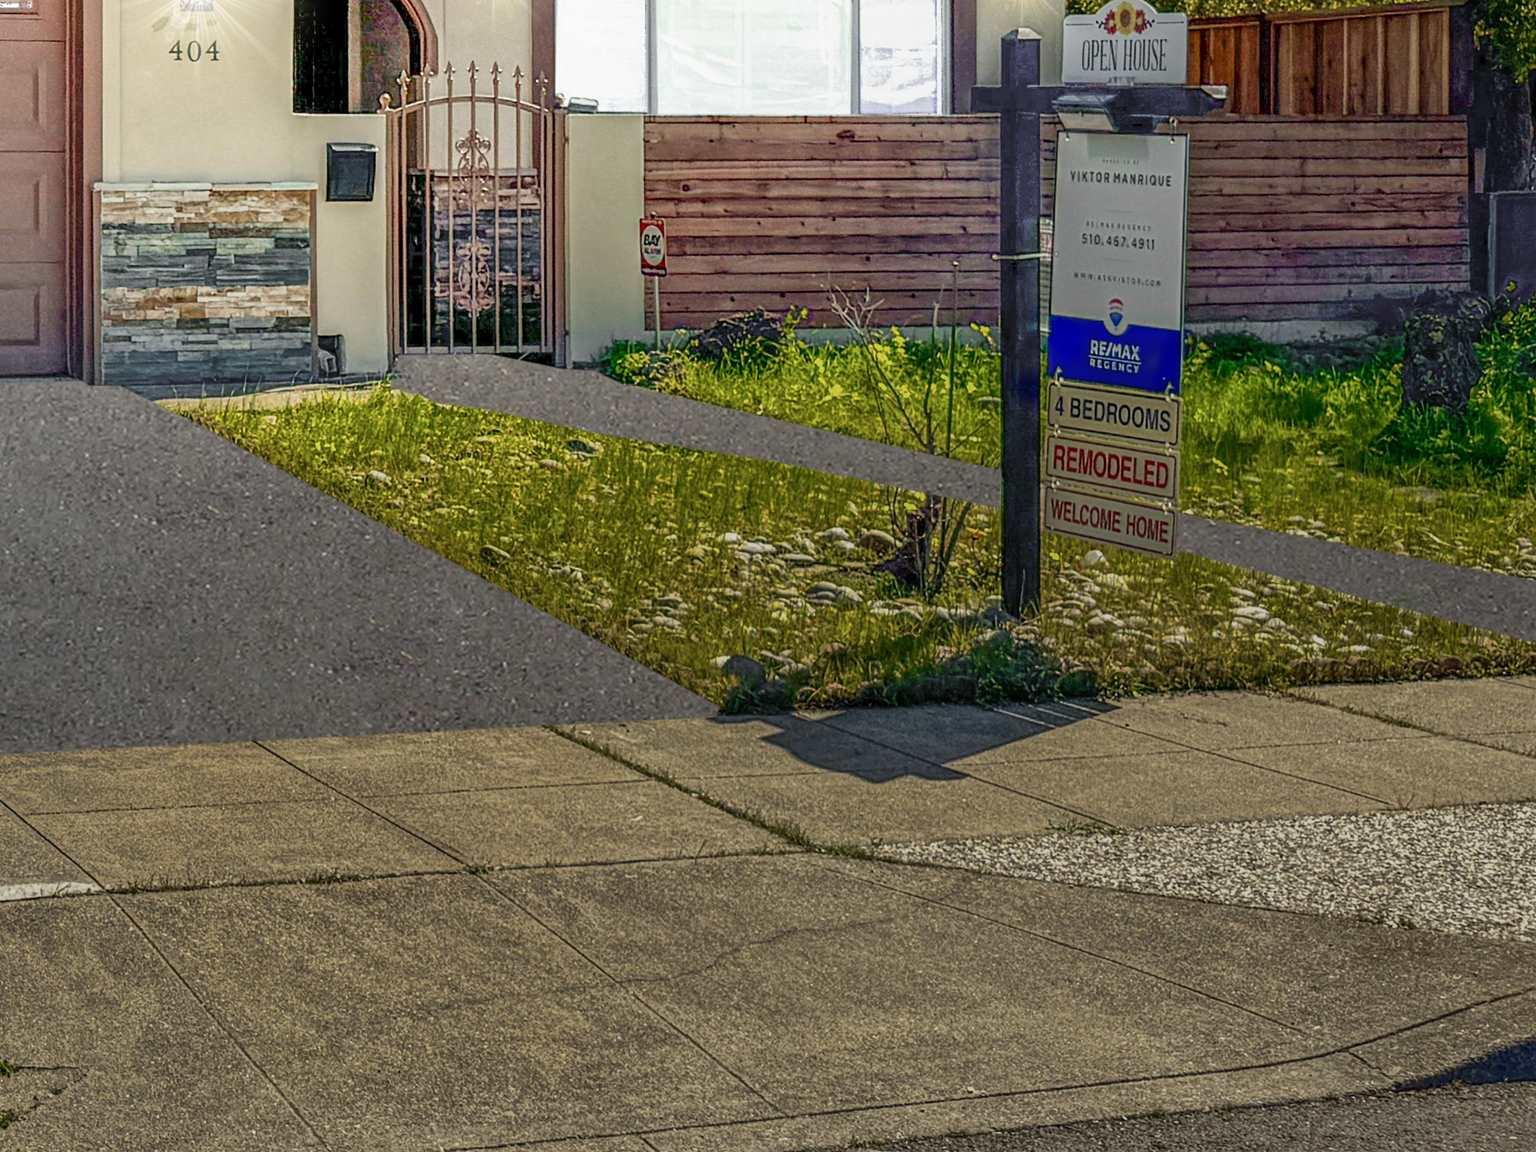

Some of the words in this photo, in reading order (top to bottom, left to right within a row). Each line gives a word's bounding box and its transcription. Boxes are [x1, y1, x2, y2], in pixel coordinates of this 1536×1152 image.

[168, 39, 220, 62] 404
[1081, 39, 1118, 72] OPEN
[1123, 38, 1168, 72] HOUSE
[1070, 170, 1110, 184] VIKTOR
[1113, 172, 1172, 187] MANRIQUE
[1081, 232, 1155, 251] 510.467.4911
[1090, 339, 1140, 361] RE/MAX
[1089, 358, 1140, 374] REGENCY
[1055, 396, 1065, 416] 4
[1070, 397, 1171, 432] BEDROOMS
[1053, 444, 1169, 489] REMODELED
[1051, 498, 1121, 534] WELCOME
[1126, 514, 1169, 543] HOME
